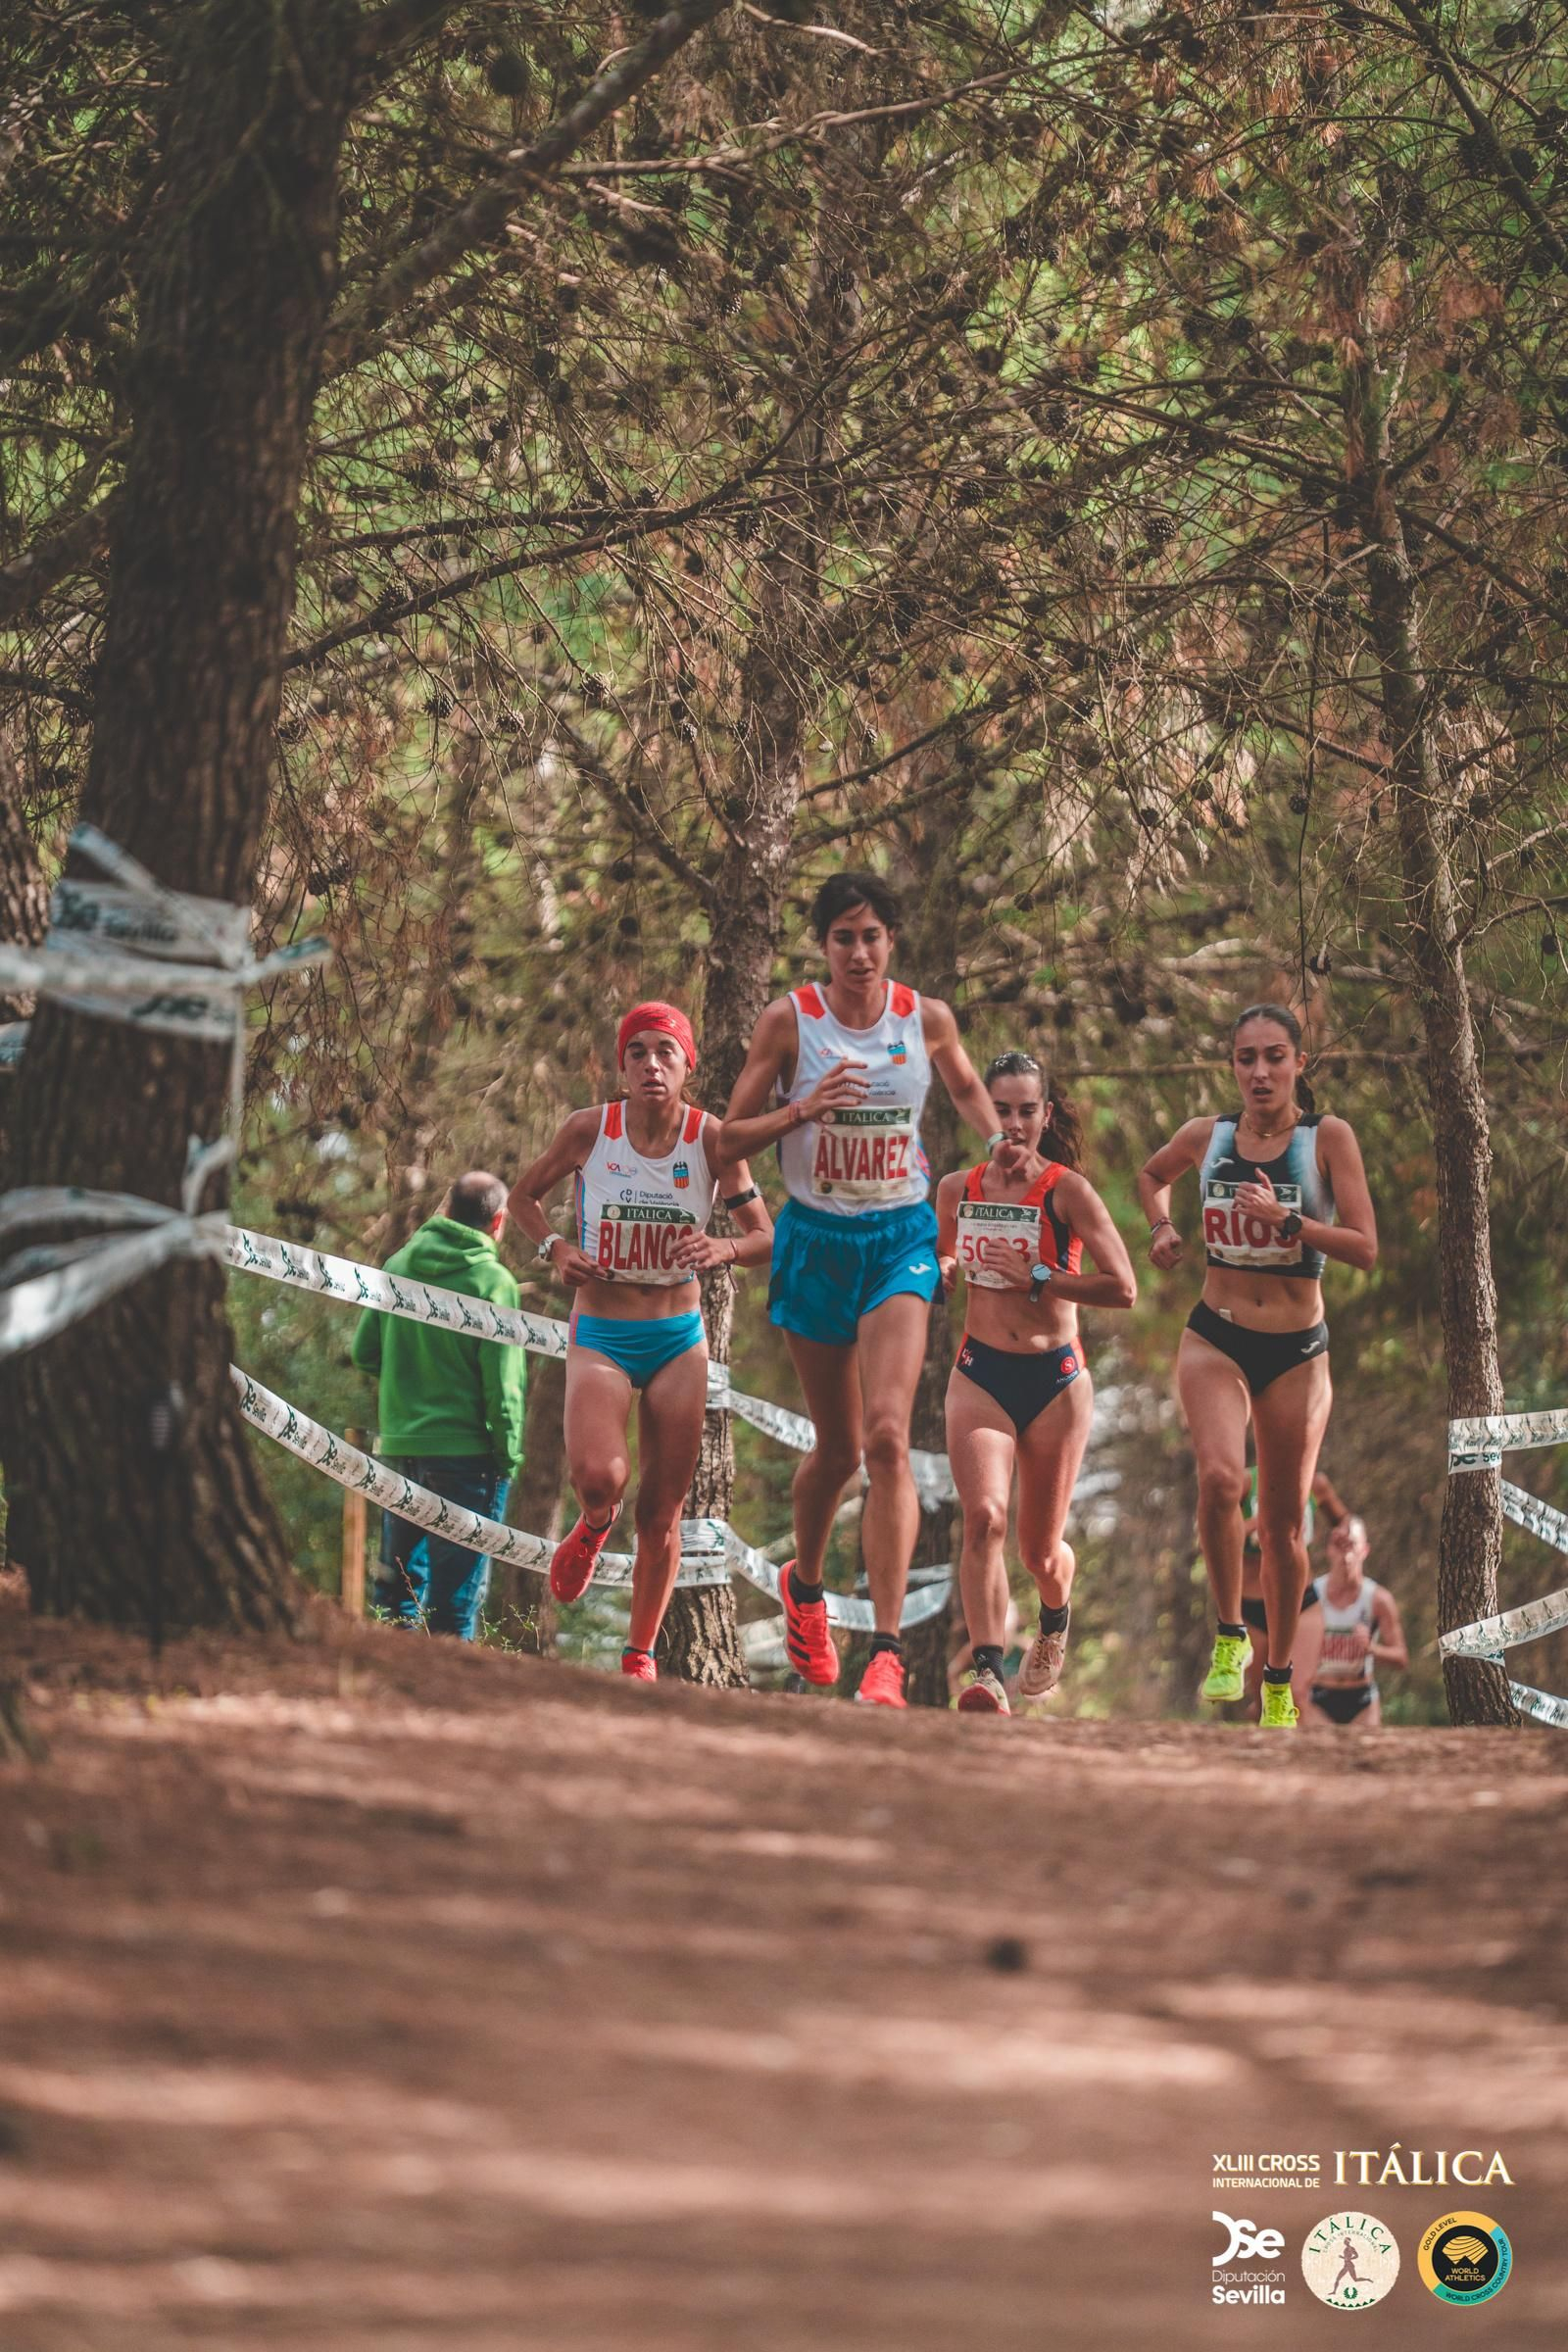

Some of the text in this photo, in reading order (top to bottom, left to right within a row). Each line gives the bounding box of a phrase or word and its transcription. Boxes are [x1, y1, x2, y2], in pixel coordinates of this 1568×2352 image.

[626, 1206, 672, 1220] ITÁLICA
[975, 1205, 1014, 1220] ITÁLICA
[962, 1235, 1031, 1264] 503
